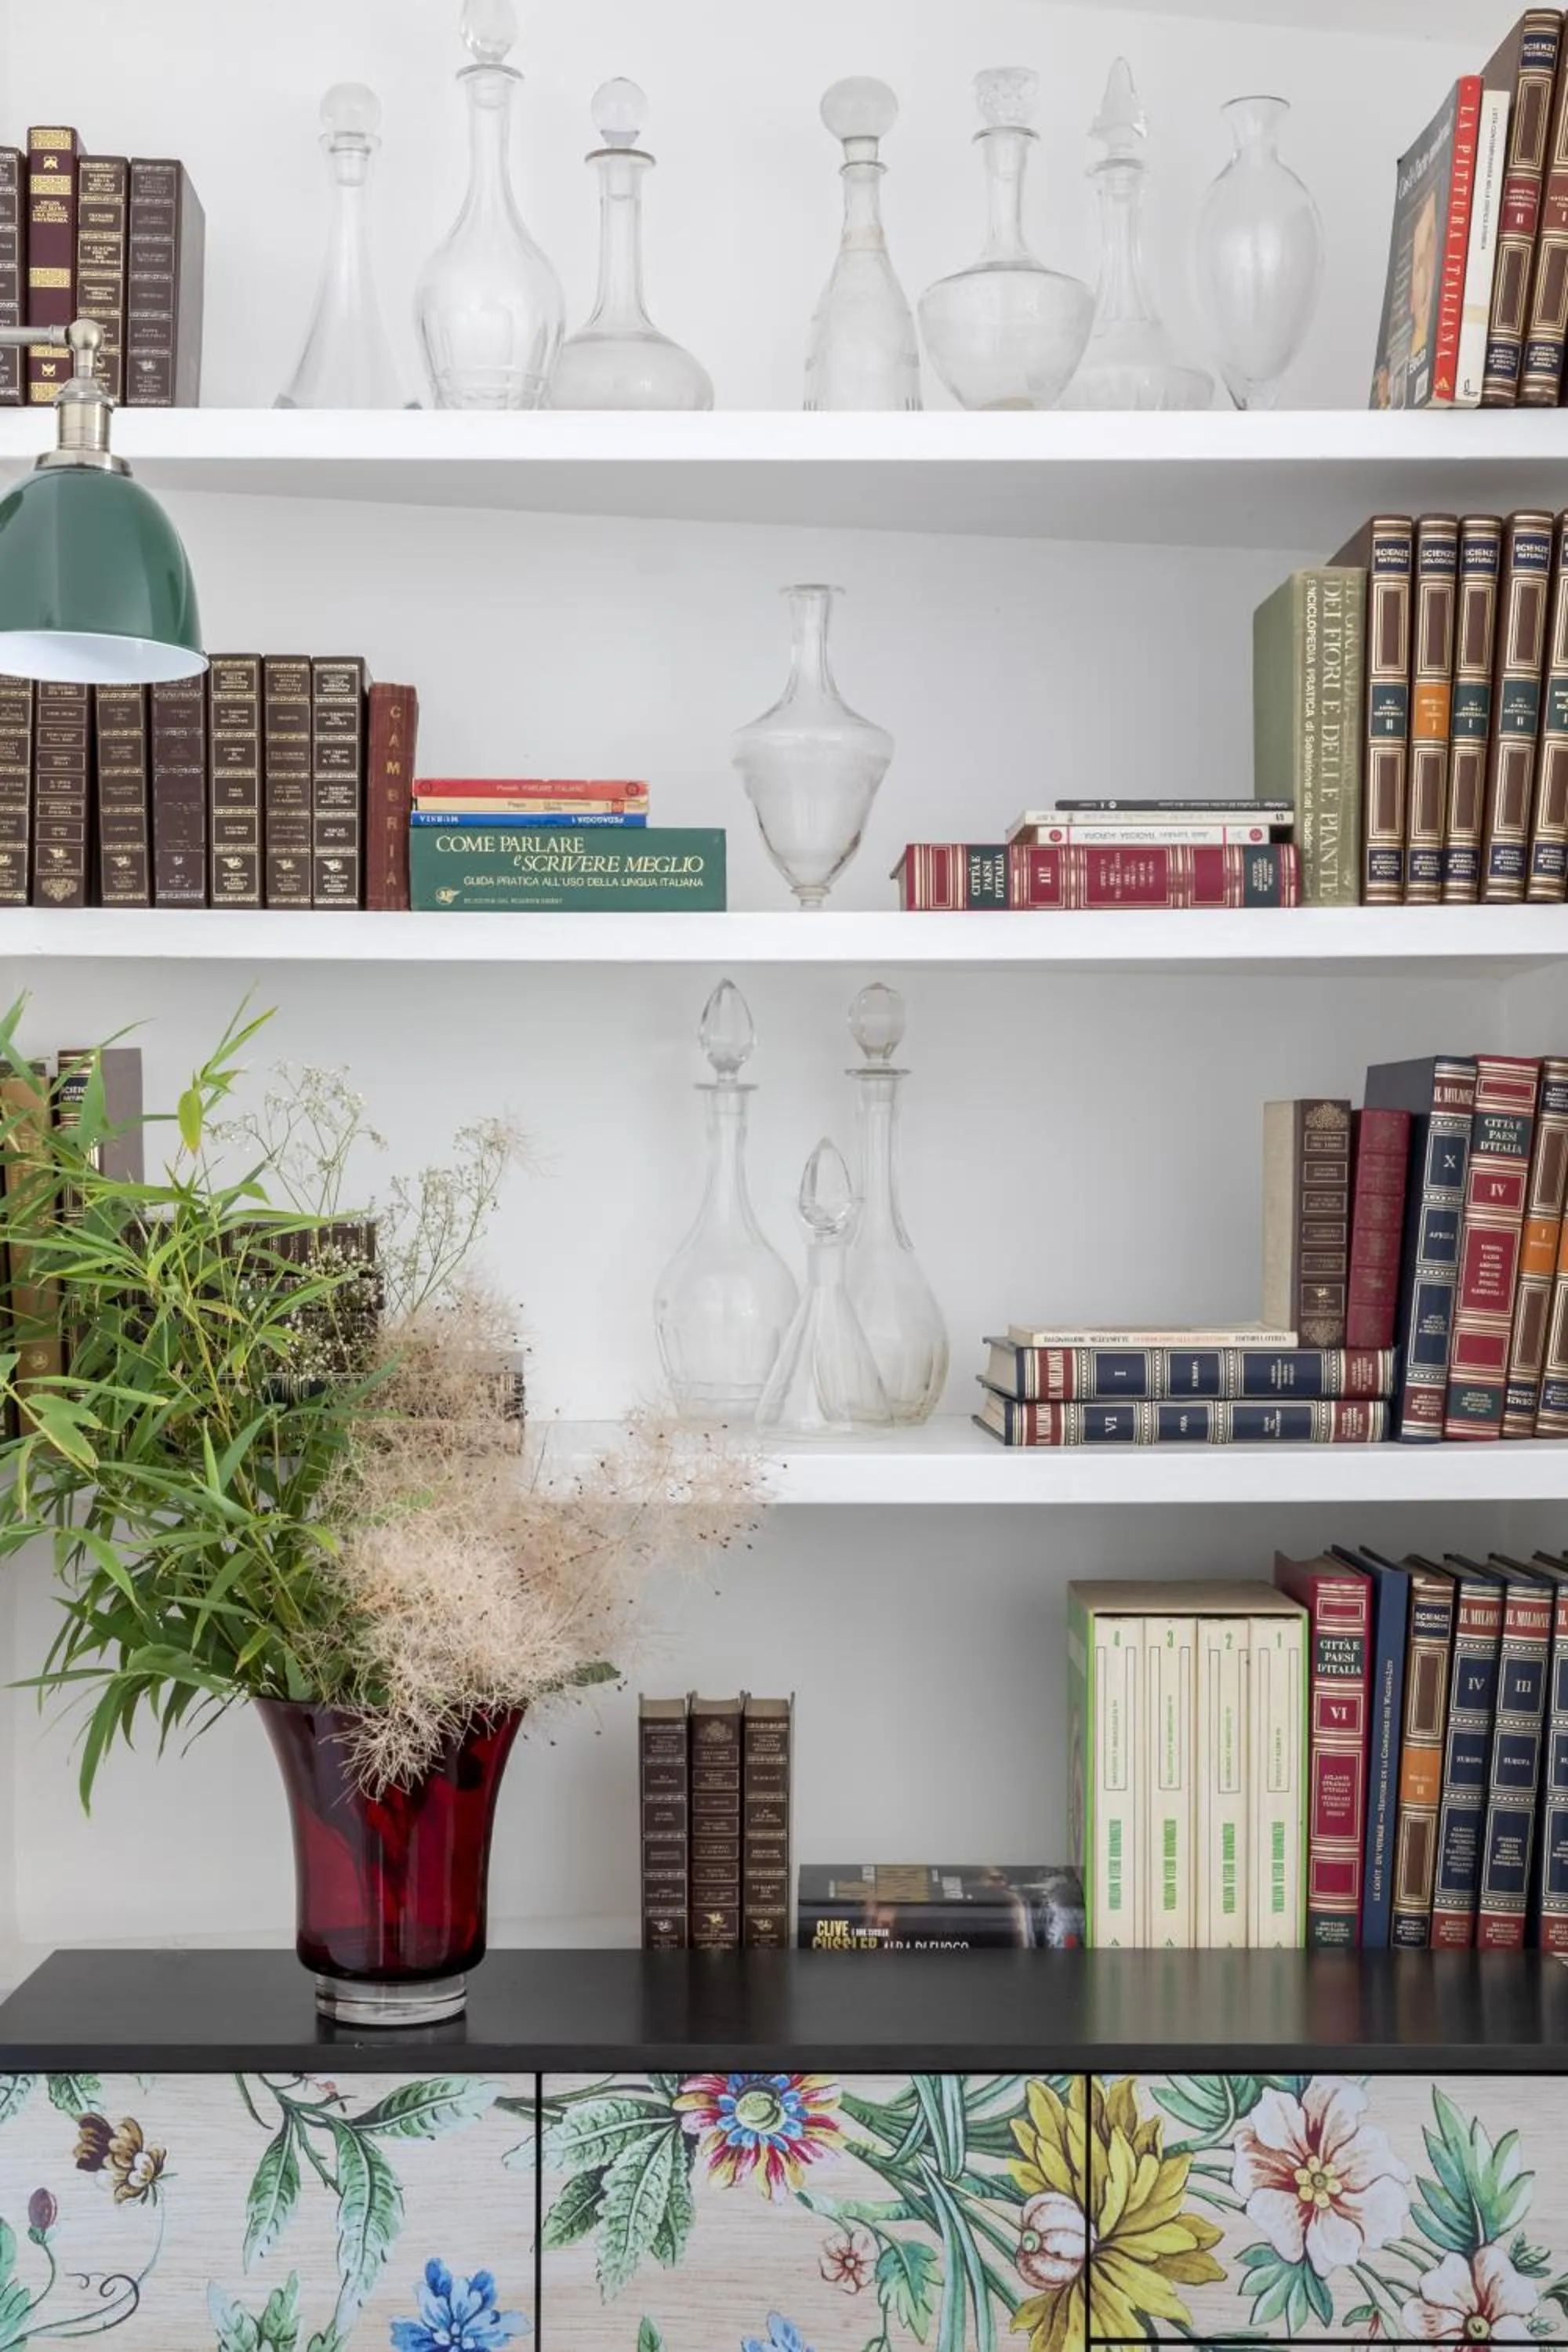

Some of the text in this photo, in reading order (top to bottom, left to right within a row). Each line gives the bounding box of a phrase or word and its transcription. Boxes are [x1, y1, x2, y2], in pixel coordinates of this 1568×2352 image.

[1436, 106, 1475, 358] LA PITTURA ITALIANA
[1305, 579, 1317, 664] ENCICLOPEDIA
[1305, 668, 1316, 717] PRATICA
[1385, 719, 1393, 730] II
[1319, 581, 1342, 898] DEI FIORI E DELLE PIANTE
[436, 835, 584, 854] COME PARLARE
[514, 855, 704, 873] e SCRIVERE MEGLIO
[463, 876, 703, 887] GUIDA PRATICA ALL'USO DELLA LINGUA ITALIANA
[969, 855, 980, 896] CITTÀ E
[982, 860, 993, 891] PAESI
[995, 853, 1004, 898] D'ITALIA
[1484, 1116, 1514, 1130] CITTÀ
[1489, 1130, 1517, 1142] PAESI
[1480, 1141, 1523, 1155] D'ITALIA
[1443, 1154, 1456, 1168] X
[1490, 1183, 1506, 1197] IV
[1105, 1417, 1117, 1433] VI
[1506, 1610, 1515, 1625] IL
[1167, 1631, 1174, 1647] 3
[1225, 1632, 1232, 1650] 2
[1276, 1632, 1282, 1648] 1
[1319, 1638, 1360, 1650] CITTÀ E
[1324, 1652, 1355, 1663] PAESI
[1317, 1663, 1362, 1675] D'ITALIA
[1468, 1677, 1485, 1690] IV
[1515, 1680, 1531, 1693] III
[1330, 1706, 1348, 1720] VI
[816, 1919, 849, 1937] CLIVE
